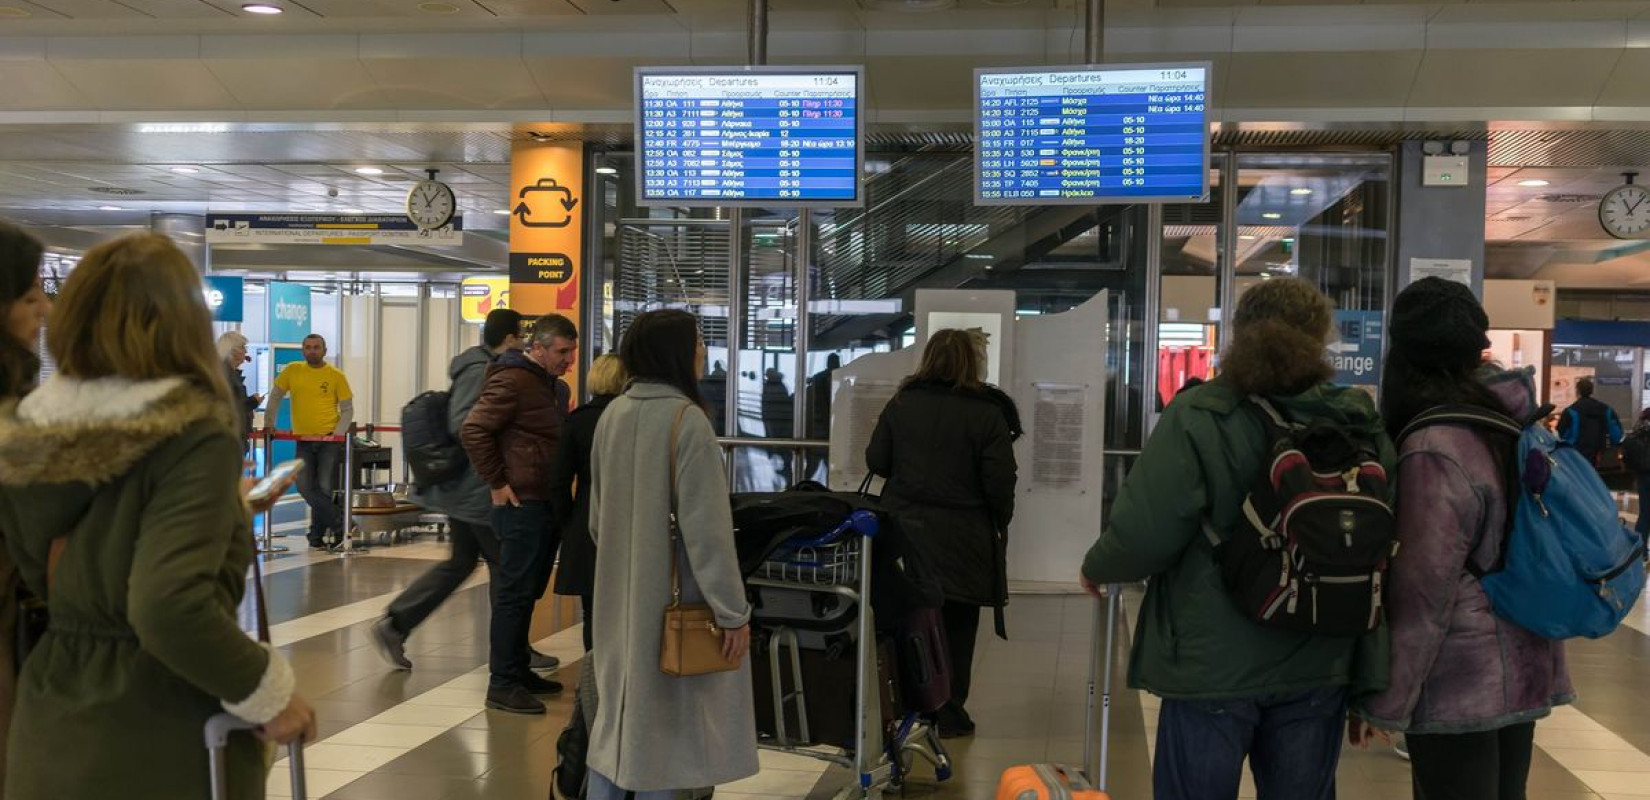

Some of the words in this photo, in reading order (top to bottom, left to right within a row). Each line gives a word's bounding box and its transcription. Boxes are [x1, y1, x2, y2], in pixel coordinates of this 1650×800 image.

[709, 78, 758, 87] Departures
[814, 77, 839, 86] 11:04
[981, 76, 1042, 87] Αναχωρήσεις
[1049, 74, 1102, 85] Departures
[1160, 70, 1187, 80] 11:04
[1118, 85, 1148, 93] Counter
[528, 258, 564, 266] PACKING
[538, 271, 564, 279] POINT
[275, 296, 308, 326] change
